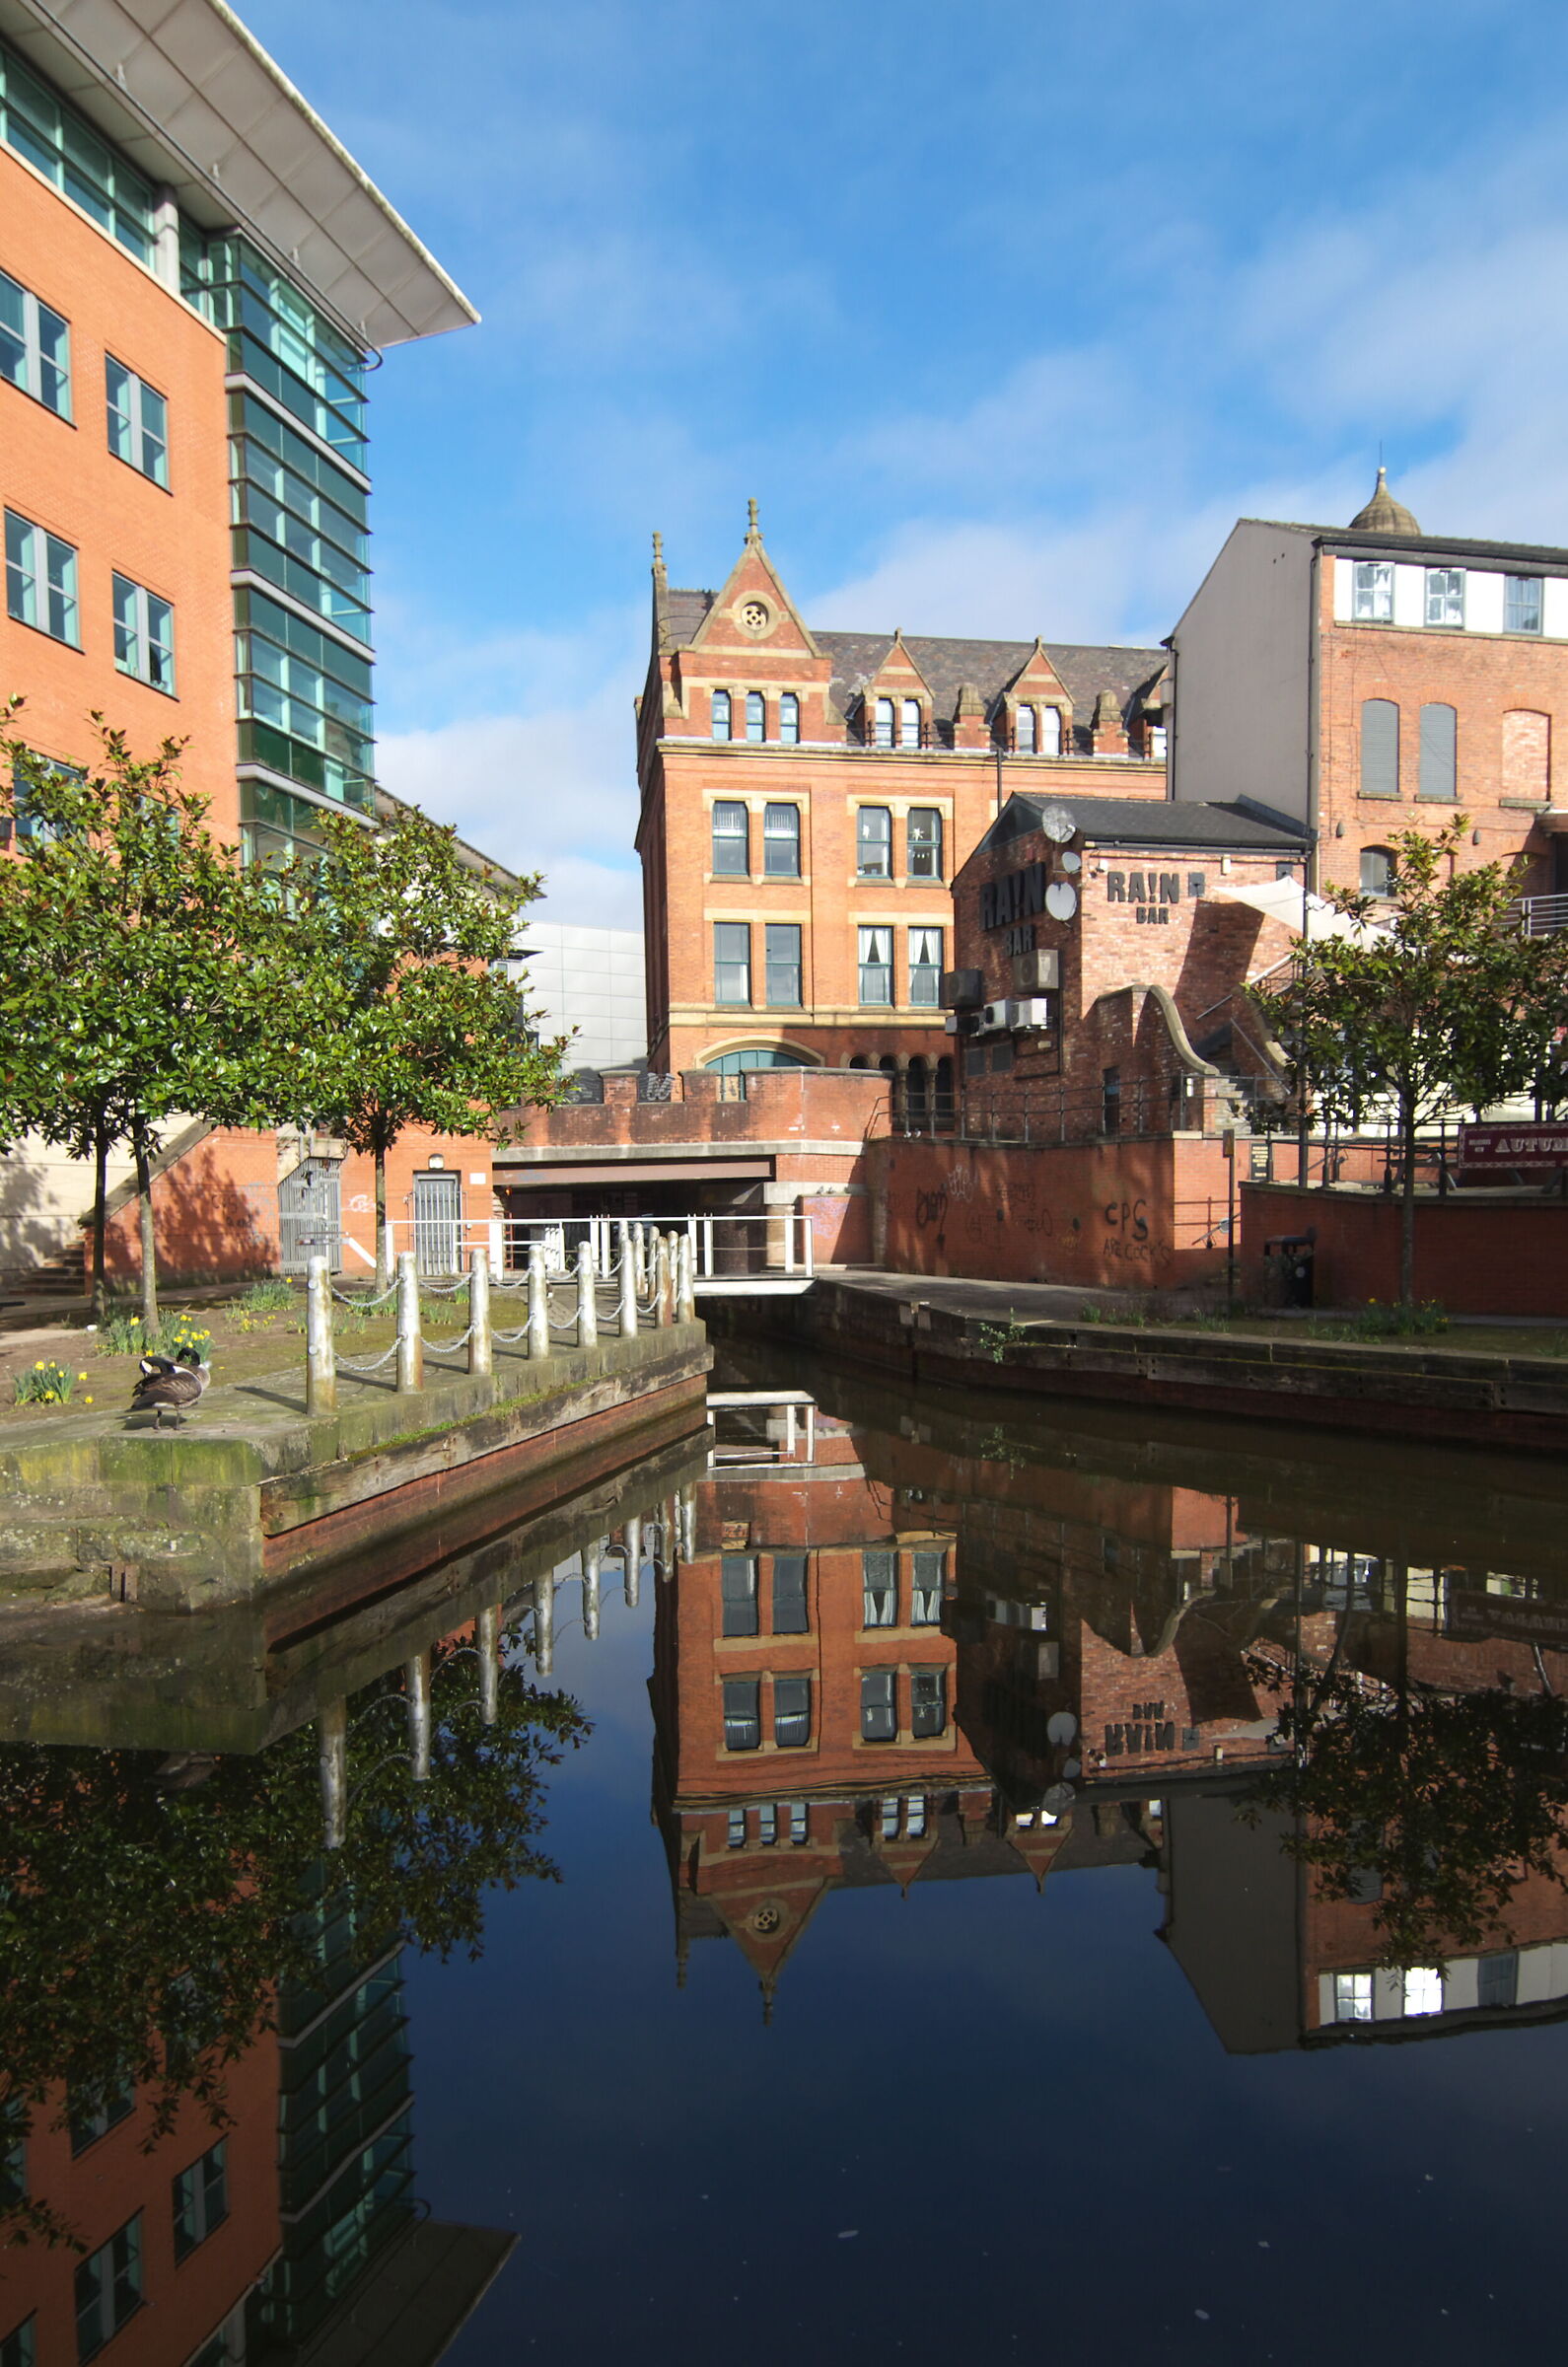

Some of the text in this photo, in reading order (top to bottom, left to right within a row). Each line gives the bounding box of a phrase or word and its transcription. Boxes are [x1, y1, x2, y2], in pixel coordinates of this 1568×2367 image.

[978, 862, 1045, 931] RA!N
[1106, 871, 1179, 903] RA!N
[1136, 906, 1169, 925] BAR
[1005, 925, 1035, 957] BAR
